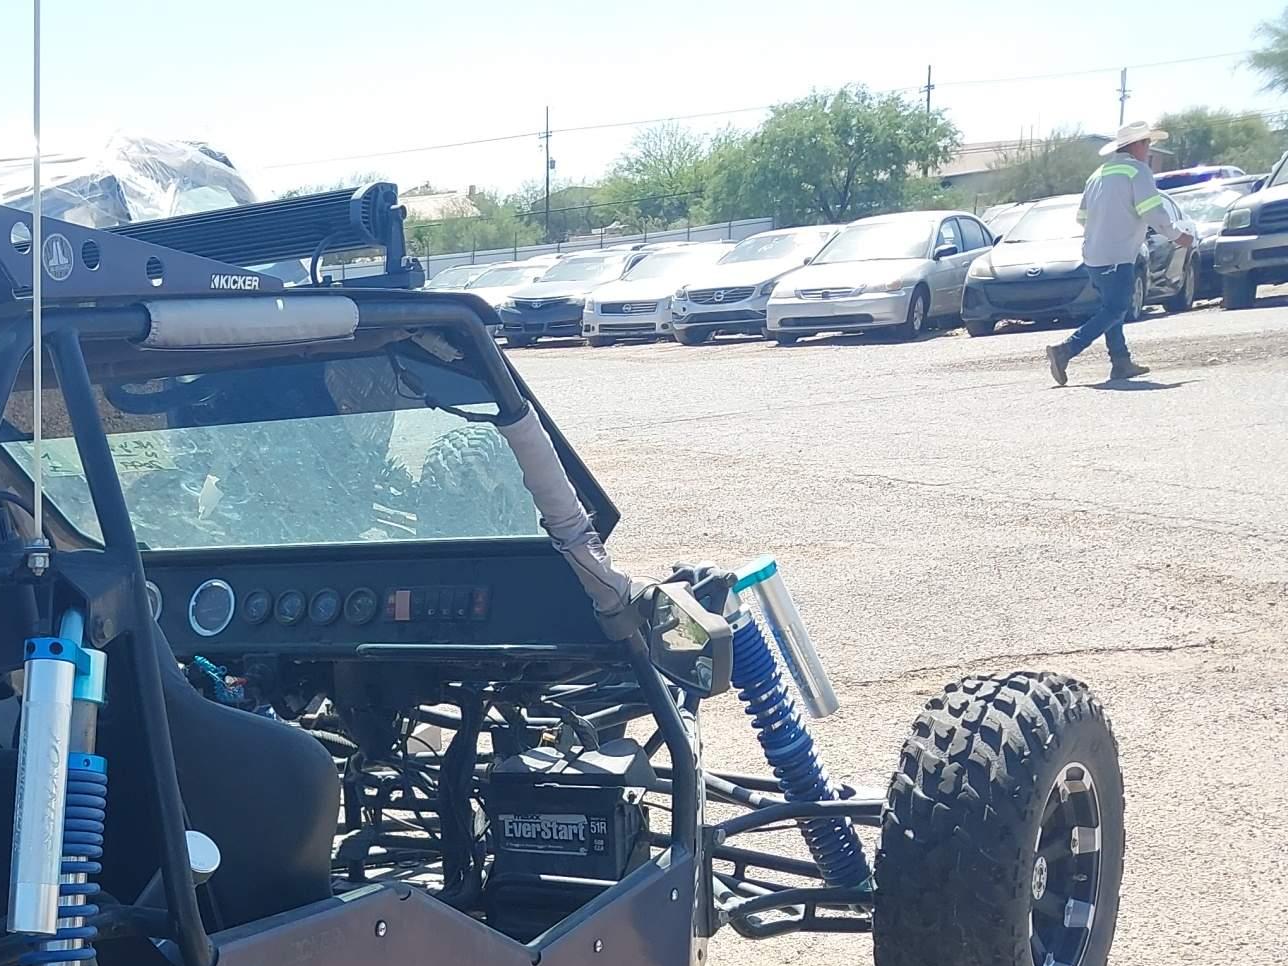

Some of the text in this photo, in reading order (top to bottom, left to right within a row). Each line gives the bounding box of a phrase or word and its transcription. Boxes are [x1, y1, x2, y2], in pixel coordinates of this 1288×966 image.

[219, 273, 260, 290] KICKER
[504, 818, 608, 841] EverStart 51R
